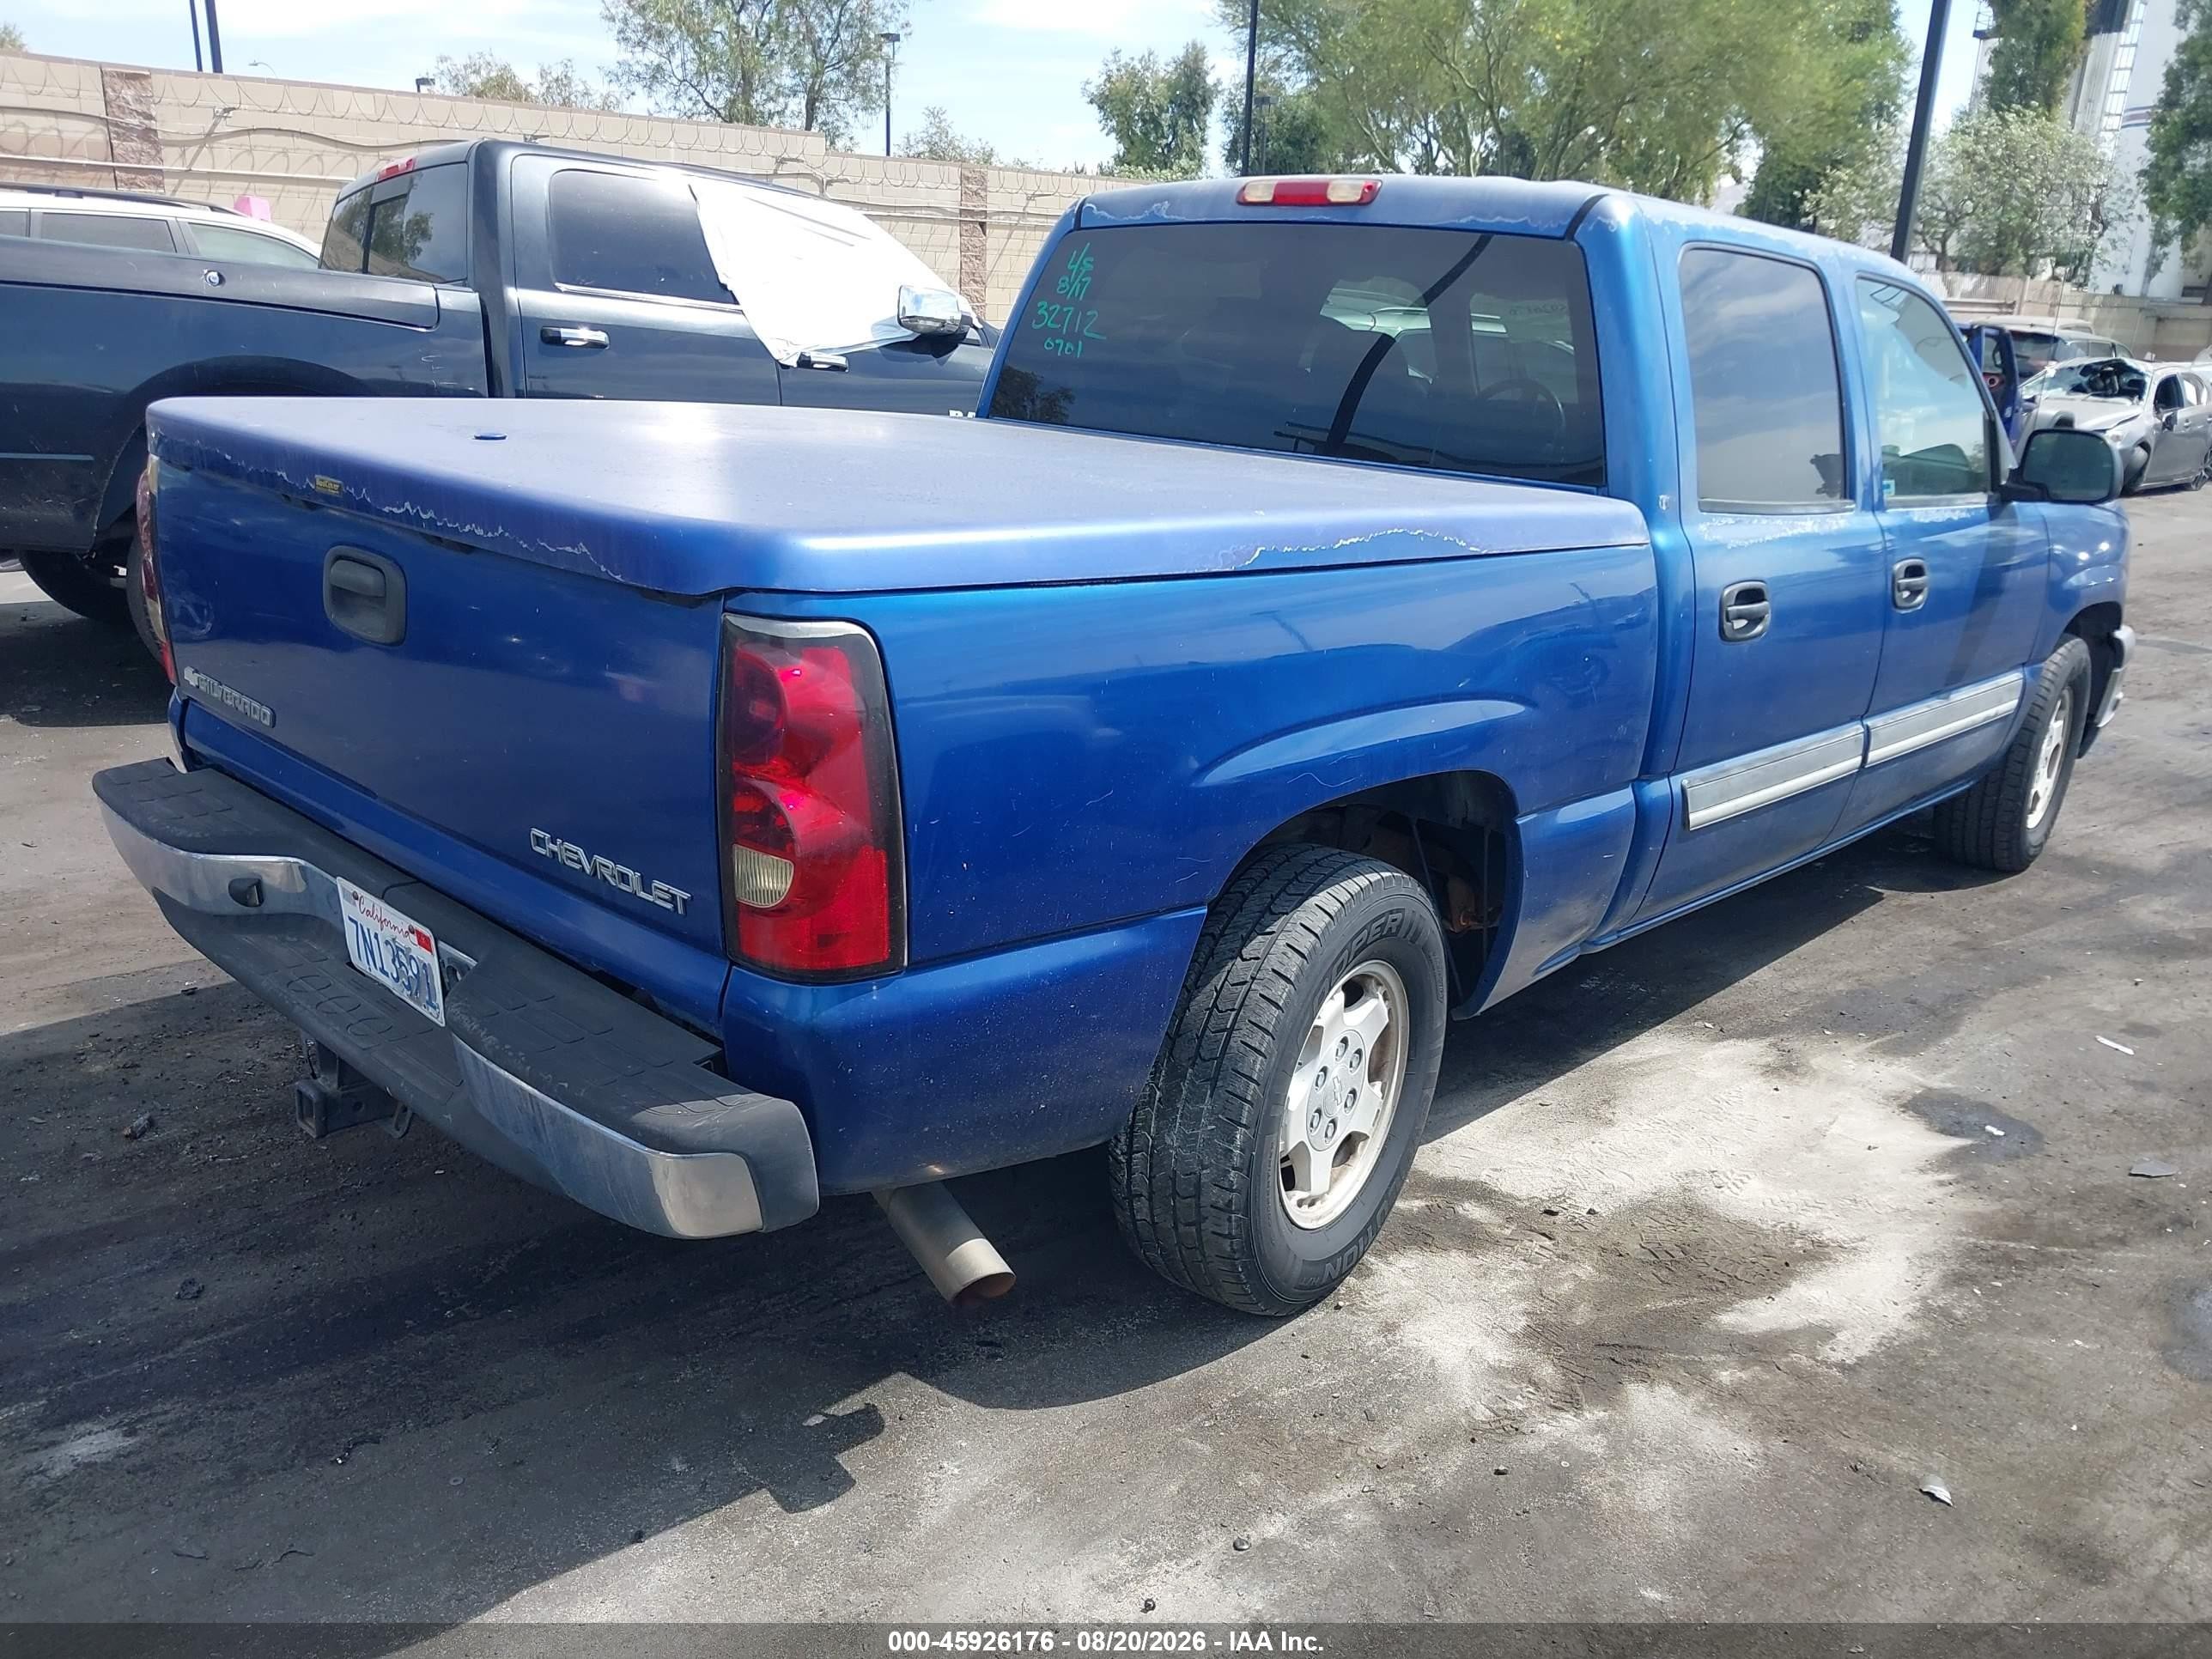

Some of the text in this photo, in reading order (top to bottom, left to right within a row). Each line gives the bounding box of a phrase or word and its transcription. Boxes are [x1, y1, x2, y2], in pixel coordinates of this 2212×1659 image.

[1031, 301, 1107, 339] 32712
[1043, 337, 1082, 358] 0701
[530, 827, 693, 915] CHEVROLET
[358, 895, 416, 945] California
